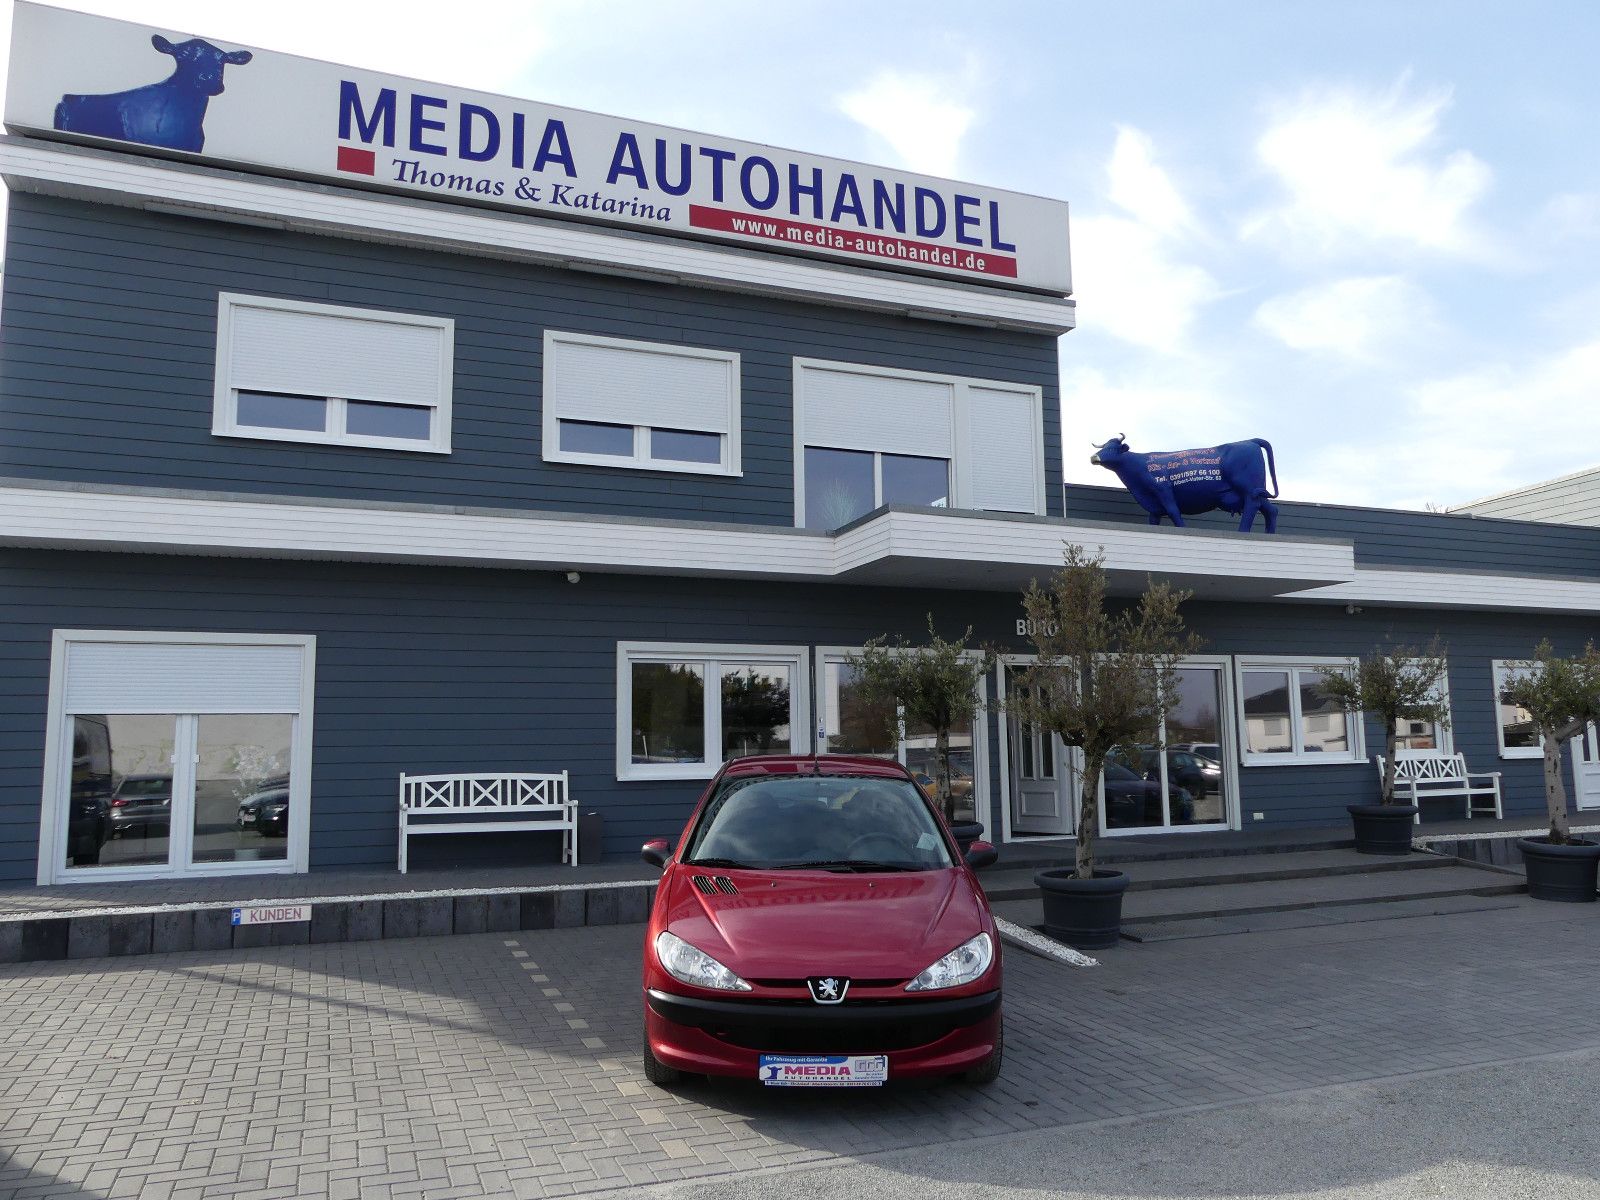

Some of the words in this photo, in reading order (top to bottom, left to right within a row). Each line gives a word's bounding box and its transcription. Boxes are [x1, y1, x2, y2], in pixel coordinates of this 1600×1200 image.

[338, 80, 577, 178] MEDIA
[606, 132, 1016, 253] AUTOHANDEL
[391, 158, 505, 197] Thomas
[514, 176, 542, 202] &
[549, 183, 672, 222] Katarina
[731, 216, 987, 272] www.media-autohandel.de
[233, 912, 241, 922] P
[250, 907, 302, 922] KUNDEN
[784, 1065, 851, 1076] MEDIA
